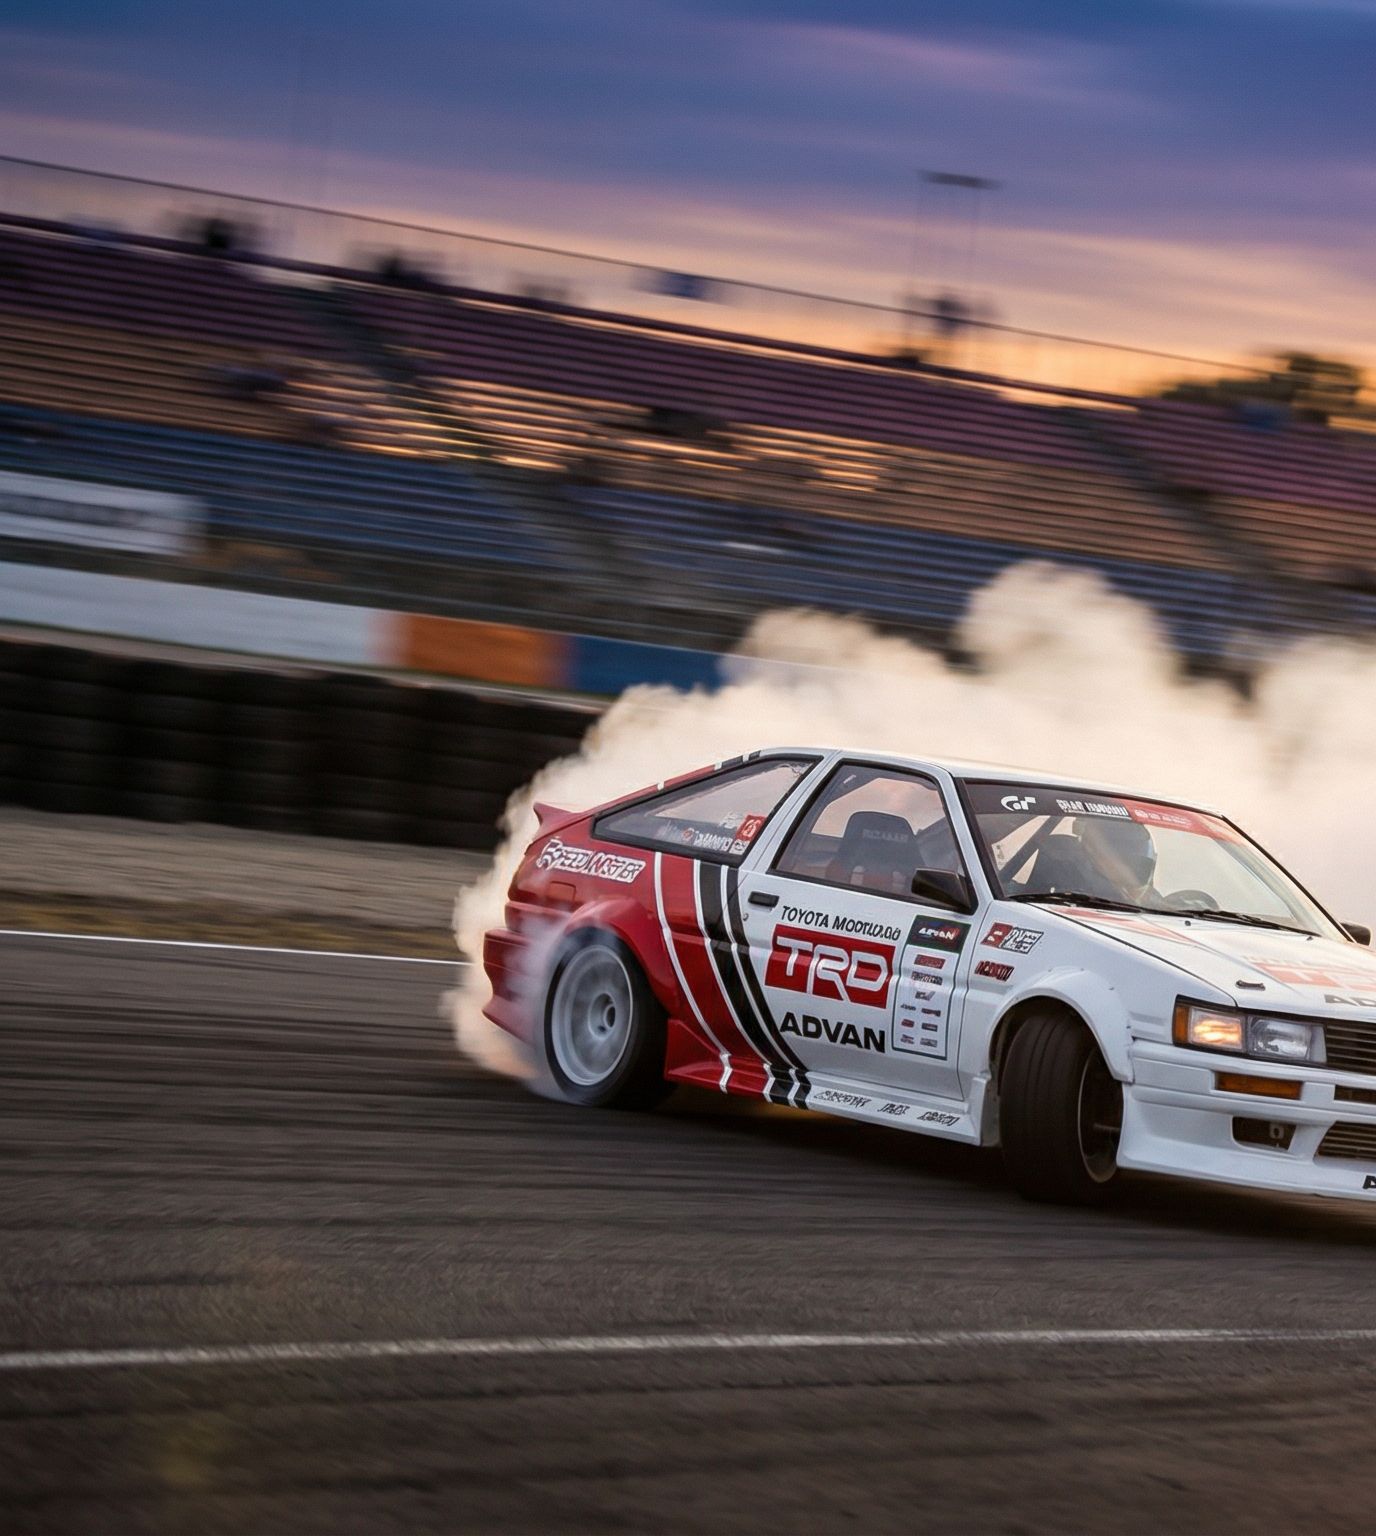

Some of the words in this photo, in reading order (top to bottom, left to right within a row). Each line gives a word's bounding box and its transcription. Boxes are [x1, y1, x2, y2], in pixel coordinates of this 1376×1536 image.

[781, 905, 829, 928] TOYOTA
[776, 935, 889, 1001] TRD
[779, 1011, 886, 1054] ADVAN
